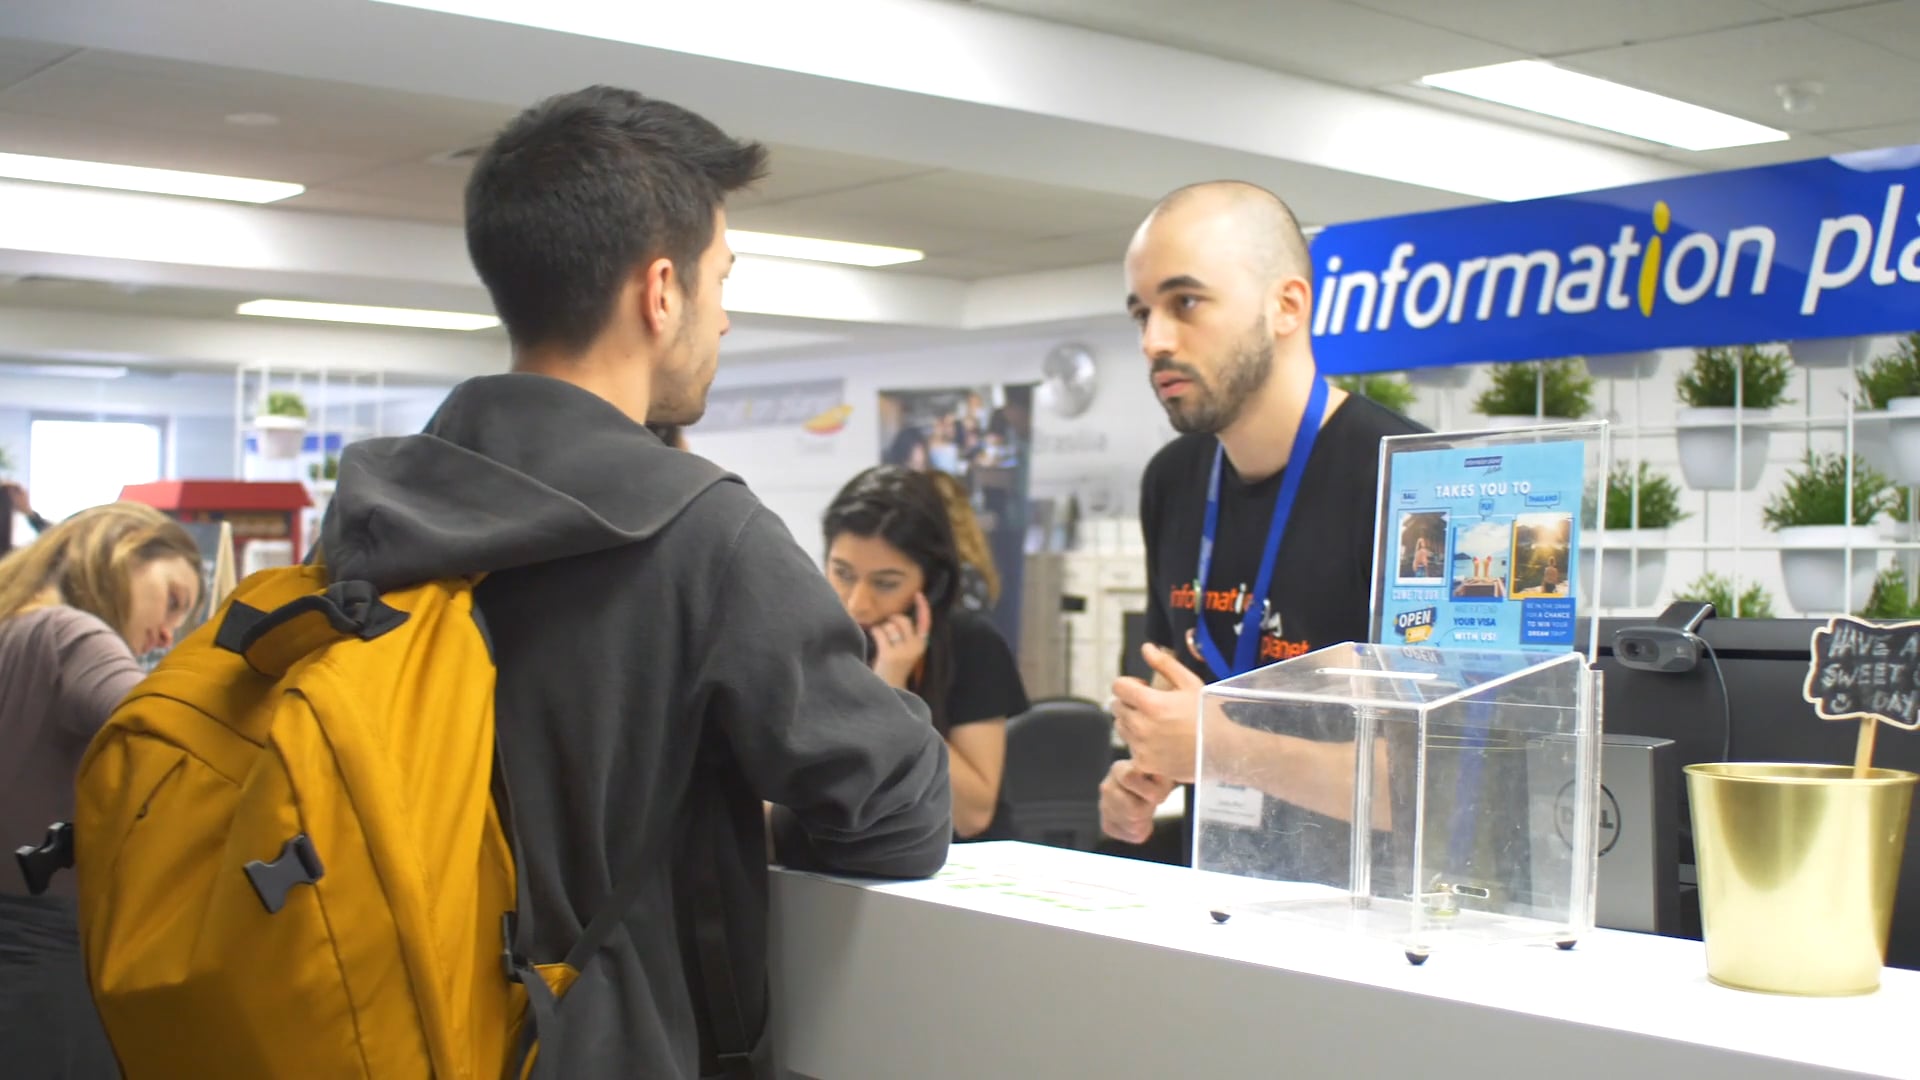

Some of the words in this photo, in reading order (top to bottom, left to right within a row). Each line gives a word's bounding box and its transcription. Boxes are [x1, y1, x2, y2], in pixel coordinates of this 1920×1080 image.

[1312, 200, 1776, 336] information
[1435, 483, 1475, 498] TAKES
[1480, 482, 1508, 496] YOU
[1511, 480, 1531, 494] TO
[1399, 609, 1432, 628] OPEN
[1453, 617, 1475, 626] YOUR
[1477, 617, 1497, 626] VISA
[1454, 631, 1478, 641] WITH
[1828, 624, 1893, 658] HAVE
[1900, 633, 1918, 658] A
[1822, 663, 1906, 687] SWEET
[1872, 690, 1917, 719] DAY
